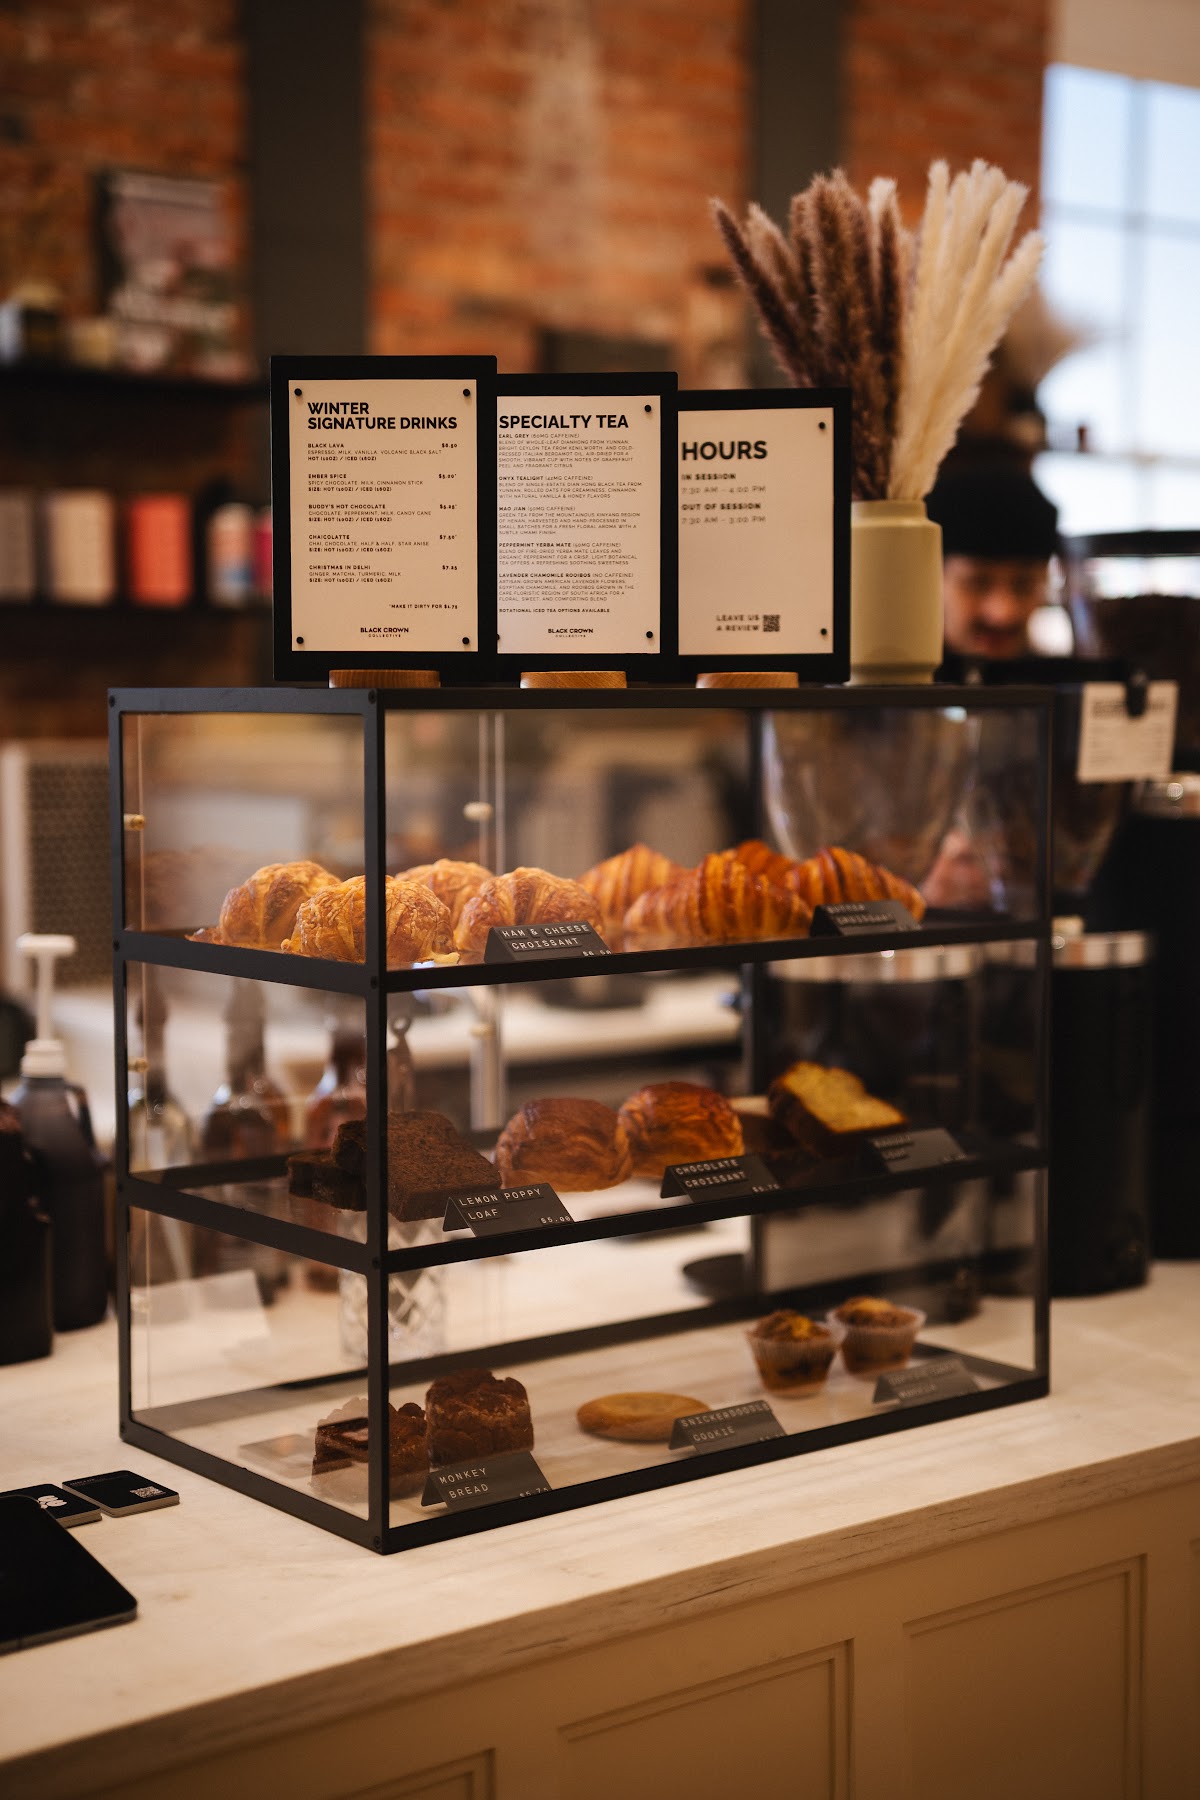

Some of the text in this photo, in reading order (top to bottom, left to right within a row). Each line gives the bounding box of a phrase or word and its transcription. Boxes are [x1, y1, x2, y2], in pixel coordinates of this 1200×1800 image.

[307, 402, 370, 415] WINTER
[307, 417, 458, 430] SIGNATURE DRINKS
[498, 414, 629, 429] SPECIALTY TEA
[682, 440, 768, 461] HOURS
[502, 924, 590, 938] HAM & CHEESE
[511, 937, 580, 950] CROISSANT
[675, 1159, 739, 1175] CHOCOLATE
[685, 1171, 747, 1188] CROISSANT
[458, 1188, 541, 1206] LEMON POPPY
[468, 1208, 498, 1221] LOAF
[692, 1425, 736, 1442] COOKIE
[439, 1467, 487, 1485] MONKEY
[448, 1483, 489, 1499] BREAD
